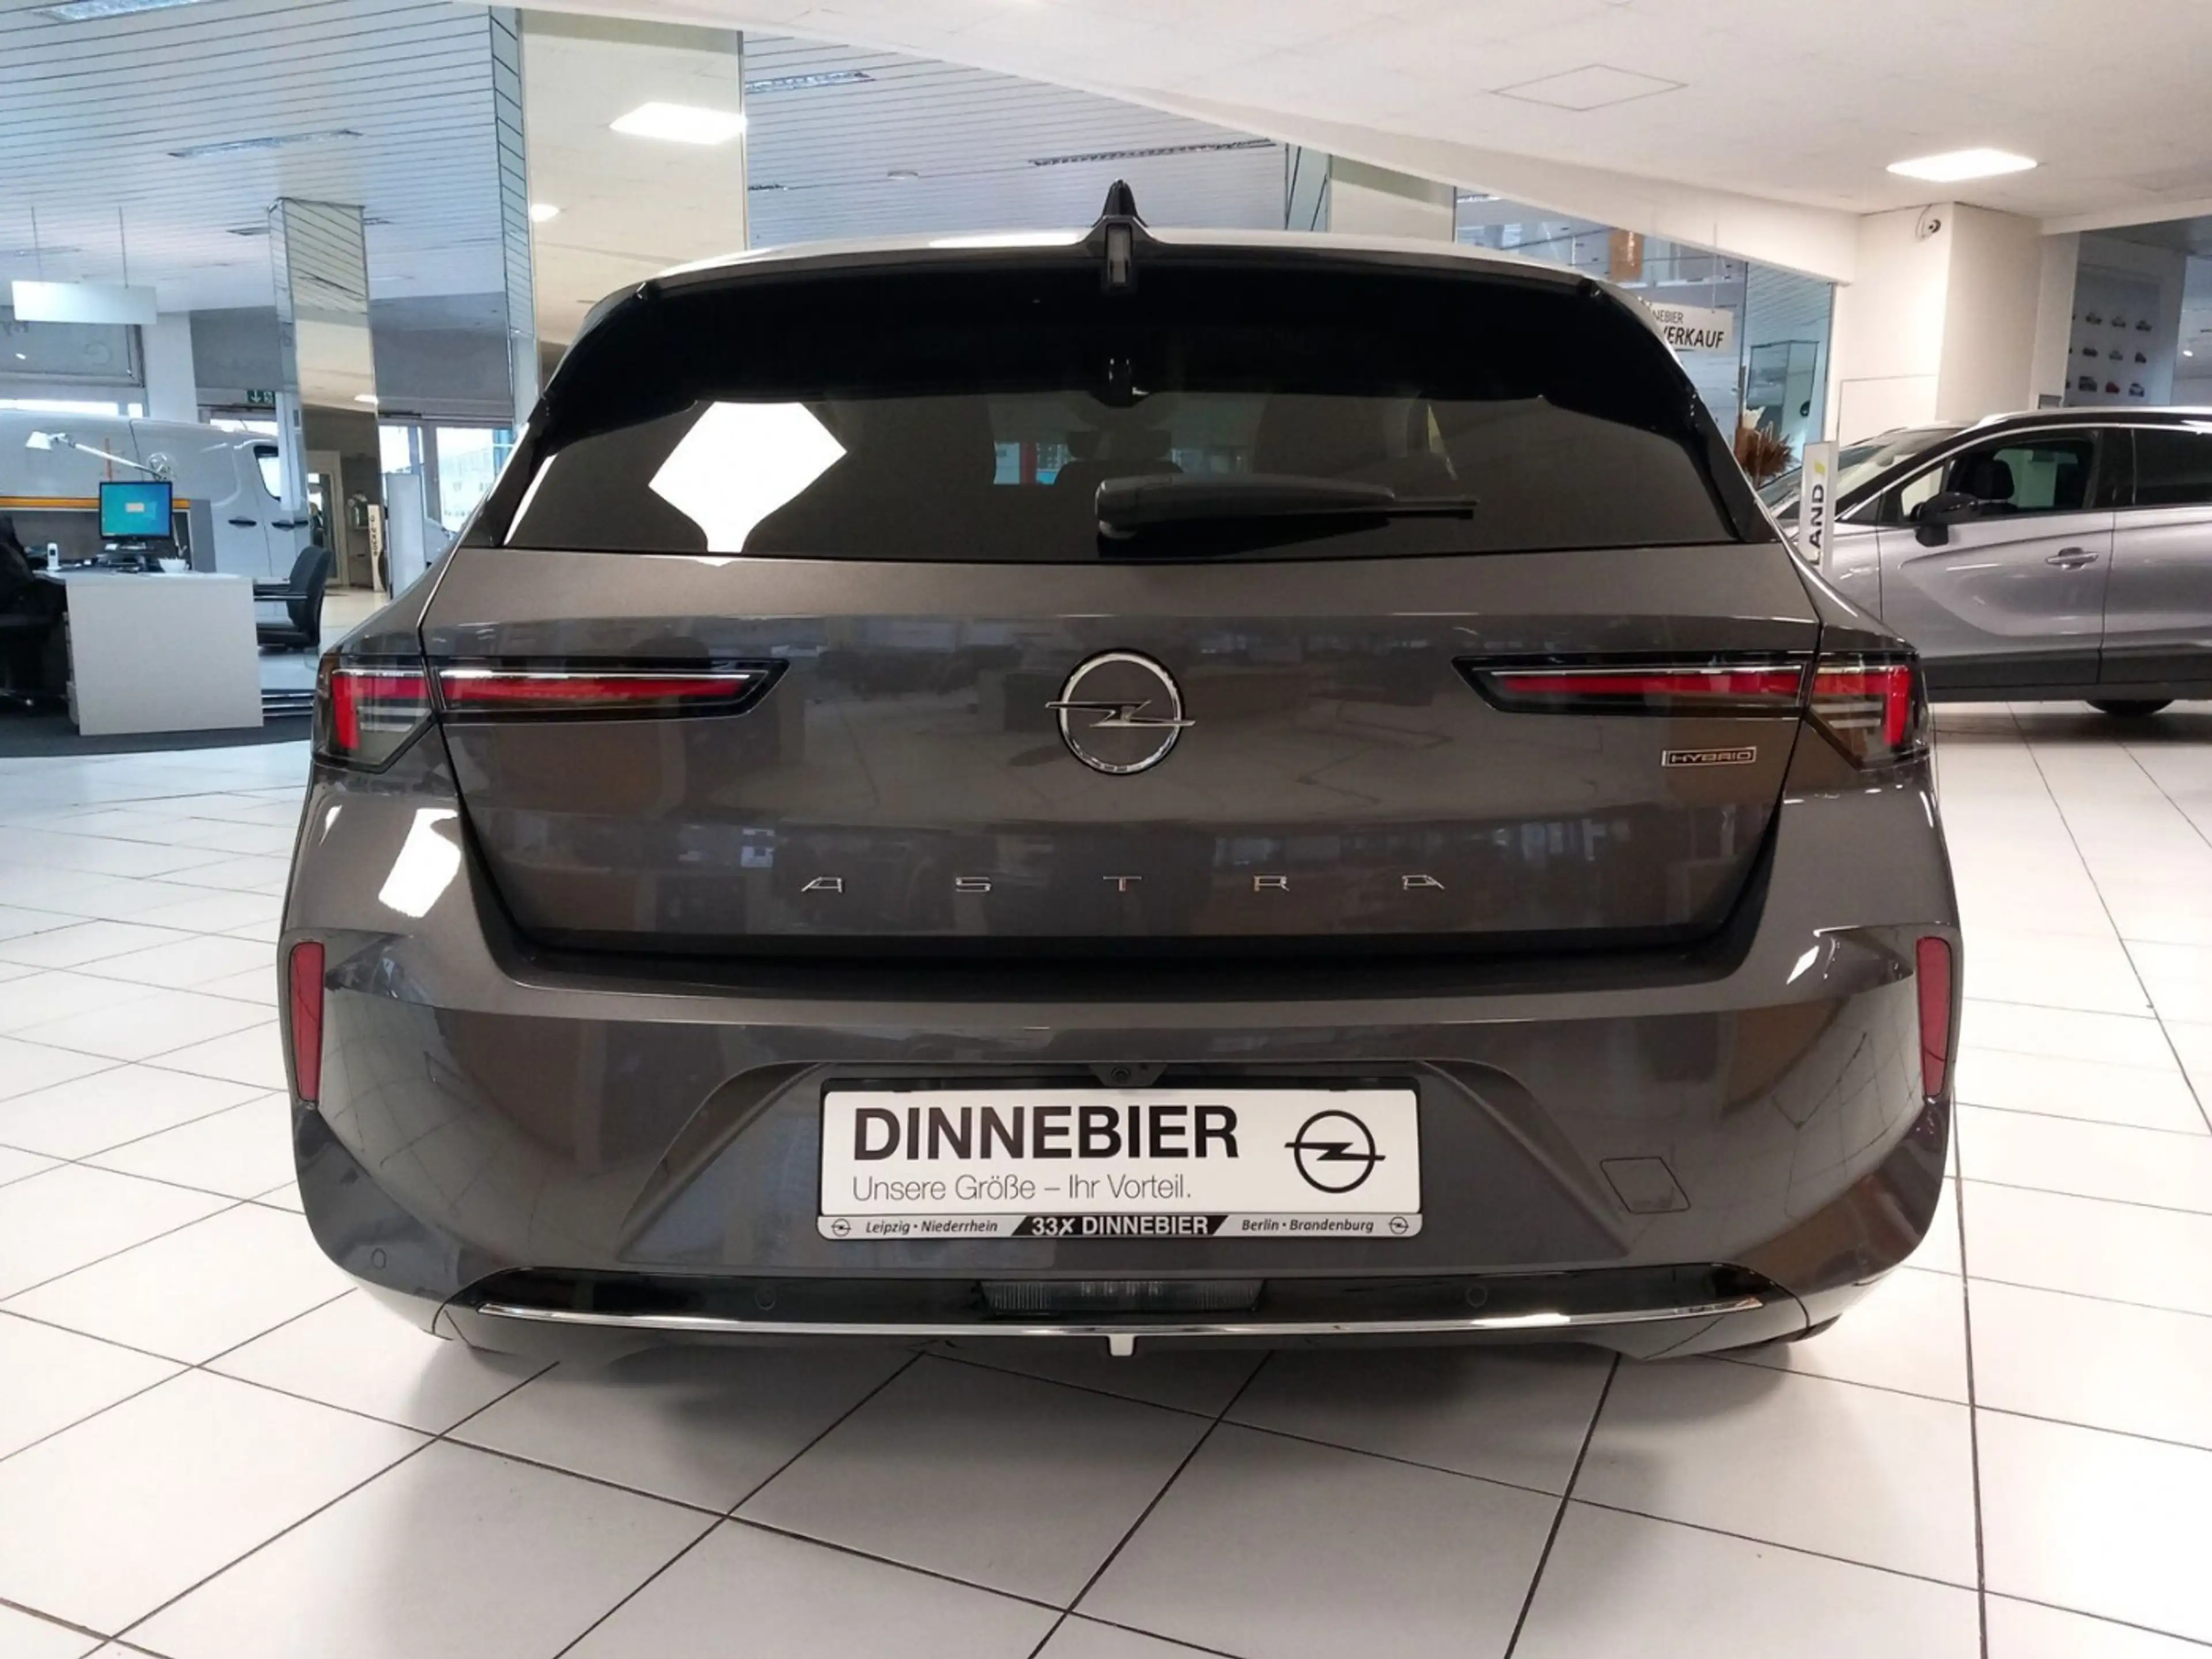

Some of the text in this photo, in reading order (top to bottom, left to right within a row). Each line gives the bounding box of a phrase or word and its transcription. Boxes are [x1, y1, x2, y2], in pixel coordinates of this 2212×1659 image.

[1671, 751, 1752, 763] HYBRID
[801, 876, 1445, 893] ASTRA
[854, 1105, 1240, 1161] DINNEBIER
[853, 1175, 946, 1201] Unsere
[955, 1173, 1036, 1200] Größe
[1069, 1173, 1100, 1199] Ihr
[1107, 1173, 1191, 1199] Vorteil.
[865, 1219, 998, 1235] Leipzig Niederrhein
[1082, 1215, 1209, 1235] DINNEBIER
[1241, 1218, 1374, 1234] Berlin Brandenburg
